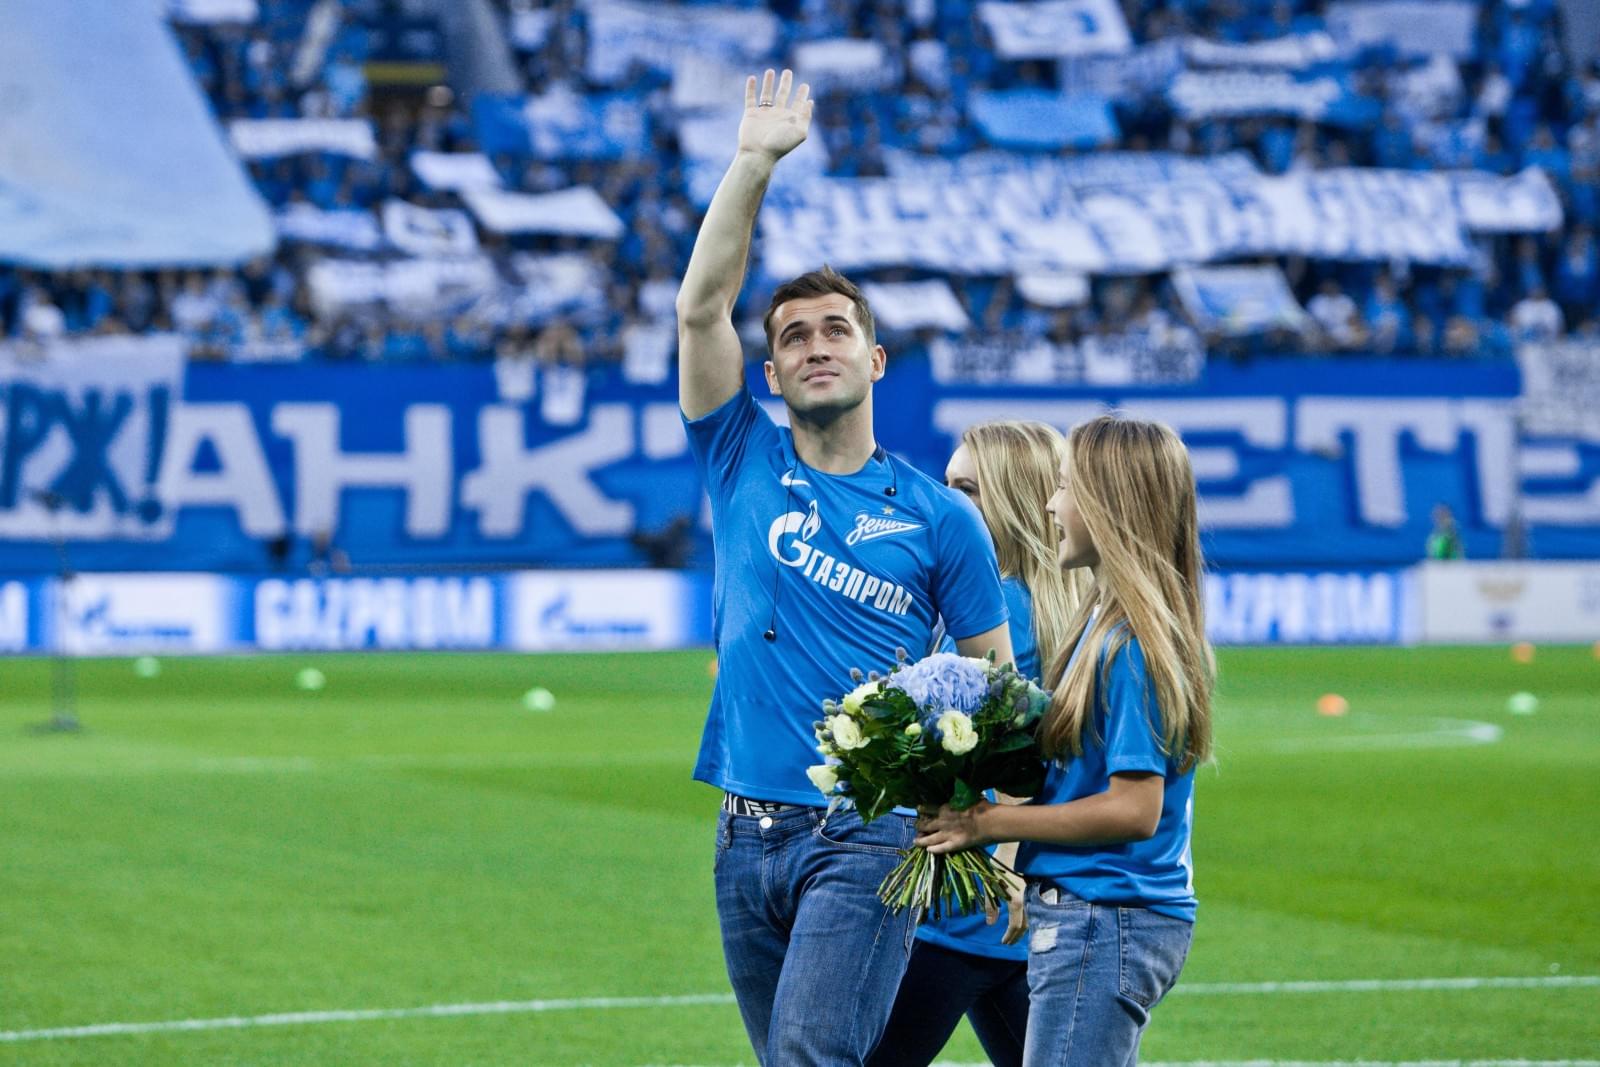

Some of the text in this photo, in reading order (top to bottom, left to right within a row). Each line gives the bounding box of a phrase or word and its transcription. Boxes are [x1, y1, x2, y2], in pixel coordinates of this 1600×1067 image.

[160, 397, 1600, 538] АНК ЕТЕ
[804, 549, 913, 615] ГАЗПРОМ
[1204, 573, 1394, 643] AZPROM
